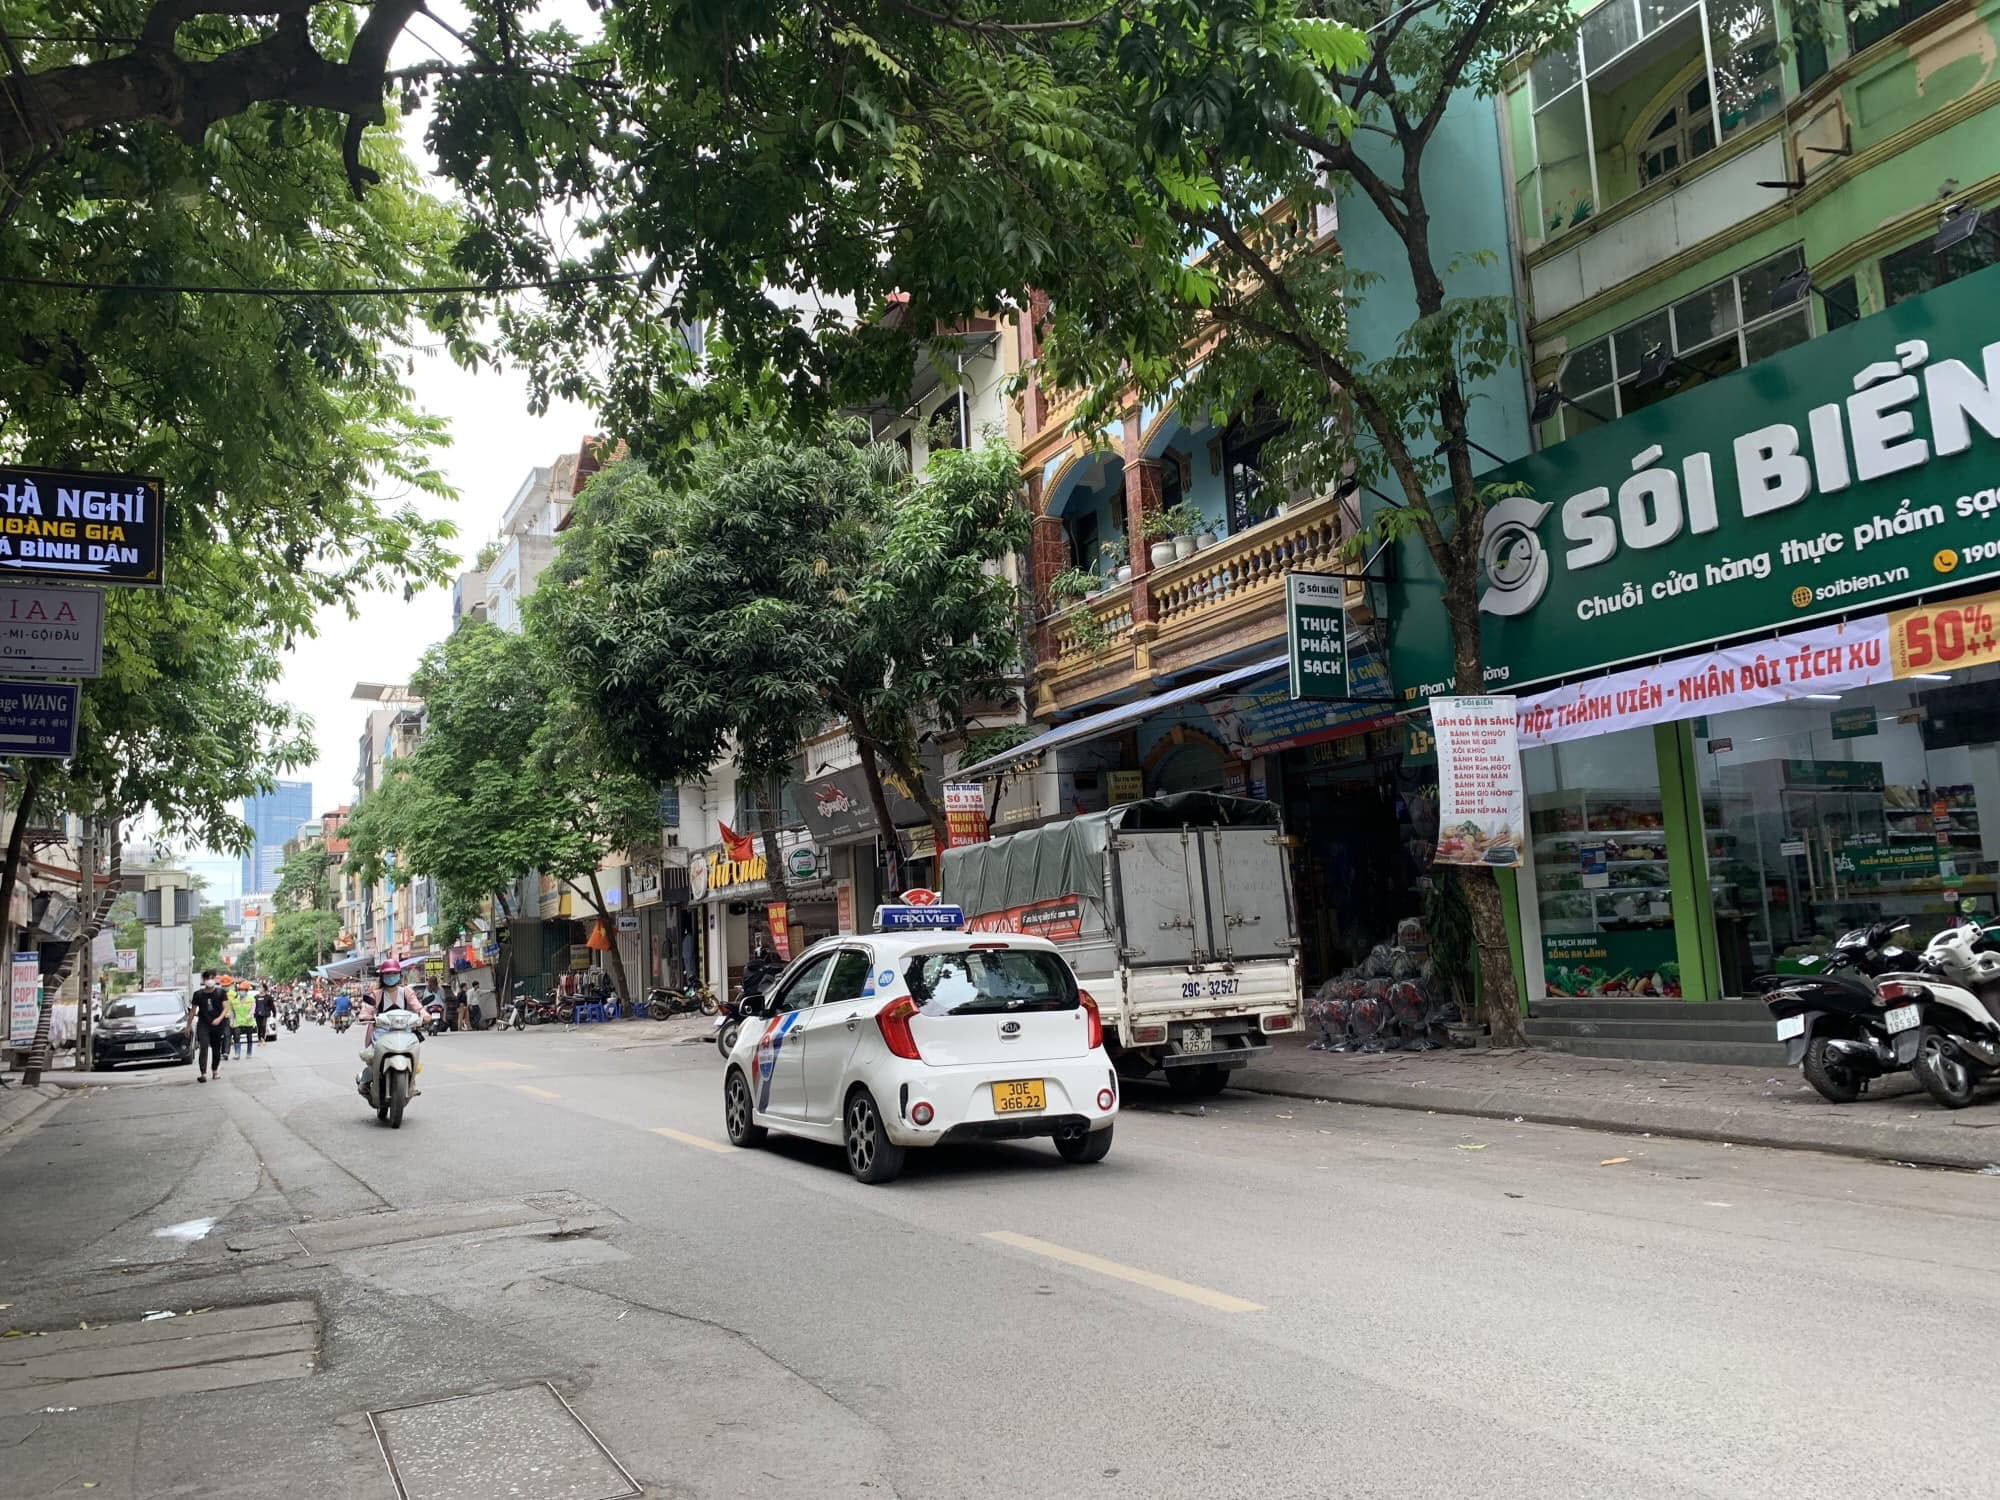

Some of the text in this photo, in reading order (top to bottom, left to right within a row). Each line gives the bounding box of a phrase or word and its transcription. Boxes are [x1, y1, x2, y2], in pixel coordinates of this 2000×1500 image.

[1562, 339, 2000, 570] SÓI BIỂN
[57, 486, 145, 523] NGHỈ
[85, 524, 126, 541] GIA
[20, 538, 80, 560] BÌNH
[88, 543, 138, 564] DÂN
[1577, 486, 2000, 620] Chuỗi cửa hàng thực phẩm sạ
[1962, 540, 2000, 564] 190
[1815, 565, 1909, 600] soibien.vn
[1301, 617, 1338, 634] THỰC
[1301, 635, 1341, 653] PHẨM
[1905, 604, 1992, 668] 50%
[1304, 660, 1340, 676] SẠCH
[1420, 682, 1445, 697] Phan
[1524, 704, 1553, 738] HỘI
[1557, 694, 1612, 728] THÀNH
[1616, 680, 1662, 715] VIÊN
[1679, 664, 1734, 703] NHÂN
[1740, 655, 1781, 692] ĐÔI
[1786, 645, 1842, 682] TÍCH
[1848, 638, 1881, 669] XU
[22, 694, 67, 711] WANG
[1182, 982, 1200, 997] 29C
[1004, 1023, 1019, 1031] KIA
[1008, 1083, 1030, 1096] 30E
[1001, 1096, 1040, 1110] 366.22
